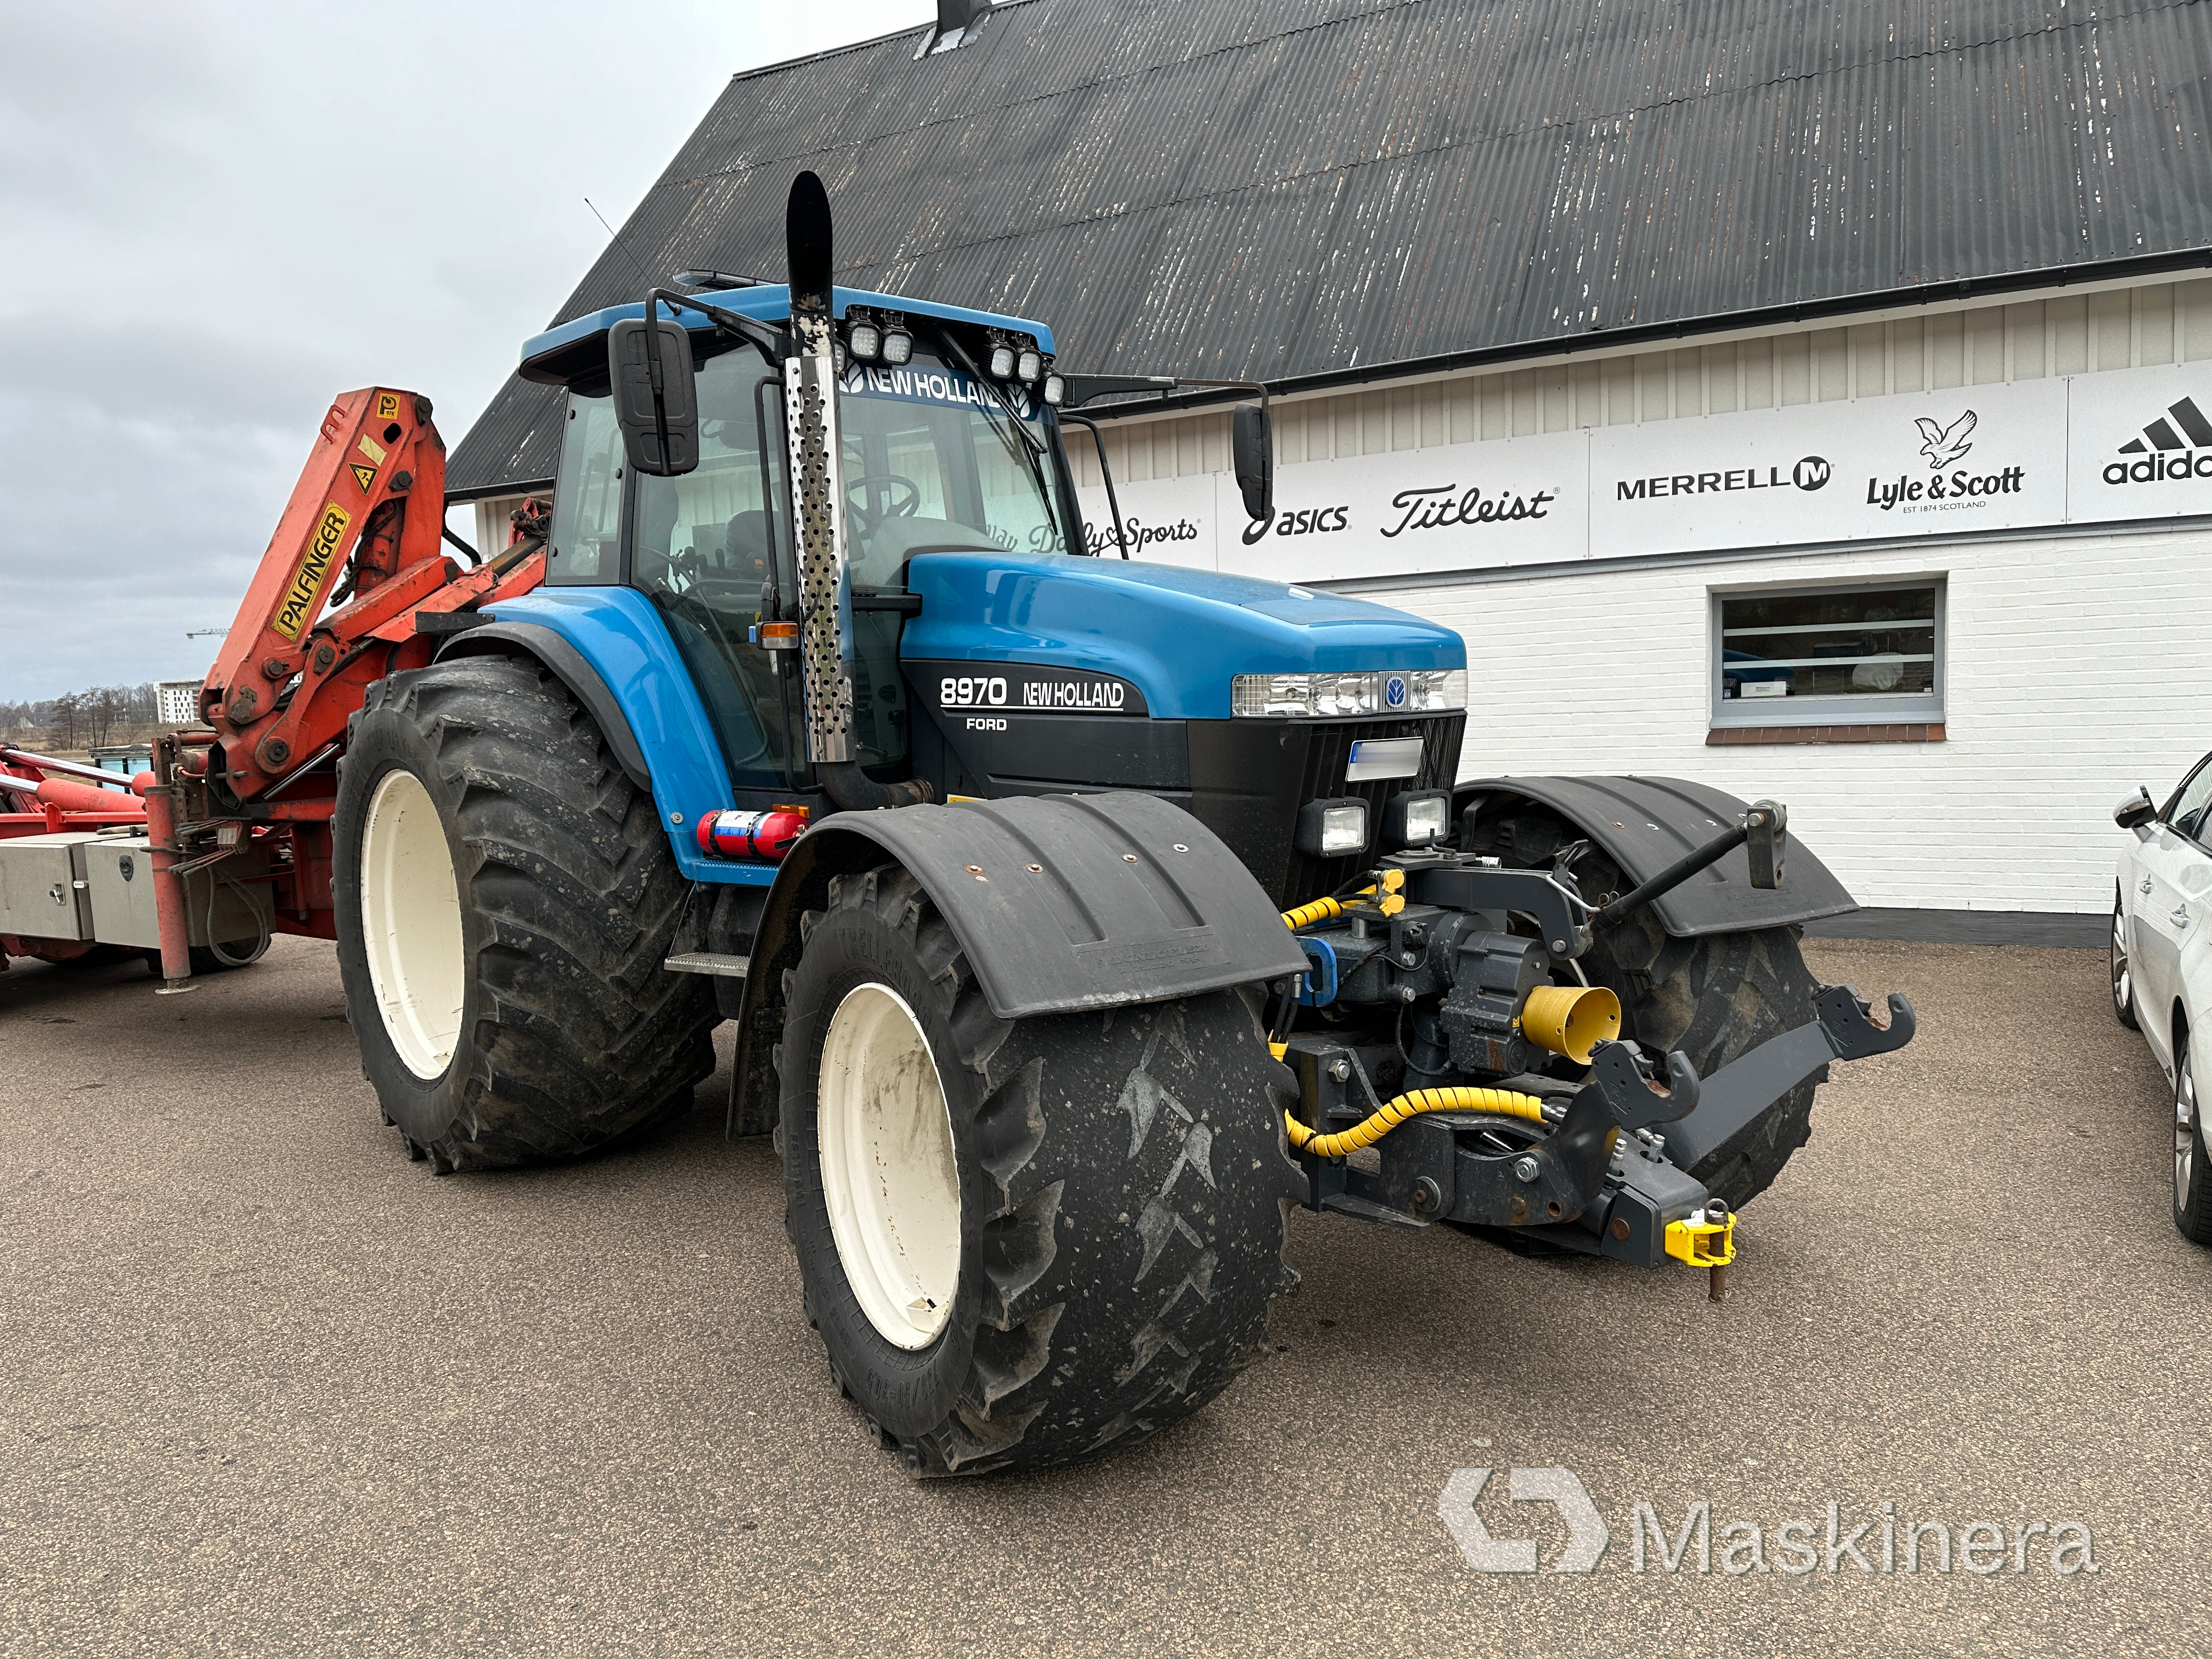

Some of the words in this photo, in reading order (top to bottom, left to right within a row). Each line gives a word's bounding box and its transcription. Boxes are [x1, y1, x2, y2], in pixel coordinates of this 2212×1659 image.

[866, 366, 912, 395] NEW
[1617, 466, 1791, 500] MERRELL
[2103, 450, 2212, 485] adida
[1866, 475, 1923, 511] Lyle
[1927, 475, 1946, 499] &
[1949, 466, 2026, 498] Scott
[1939, 500, 1986, 511] SCOTLAND
[279, 512, 345, 631] PALFINGER
[940, 677, 1007, 704] 8970
[1023, 682, 1052, 706] NEW
[1054, 682, 1125, 707] HOLLAND
[966, 718, 1007, 731] FORD
